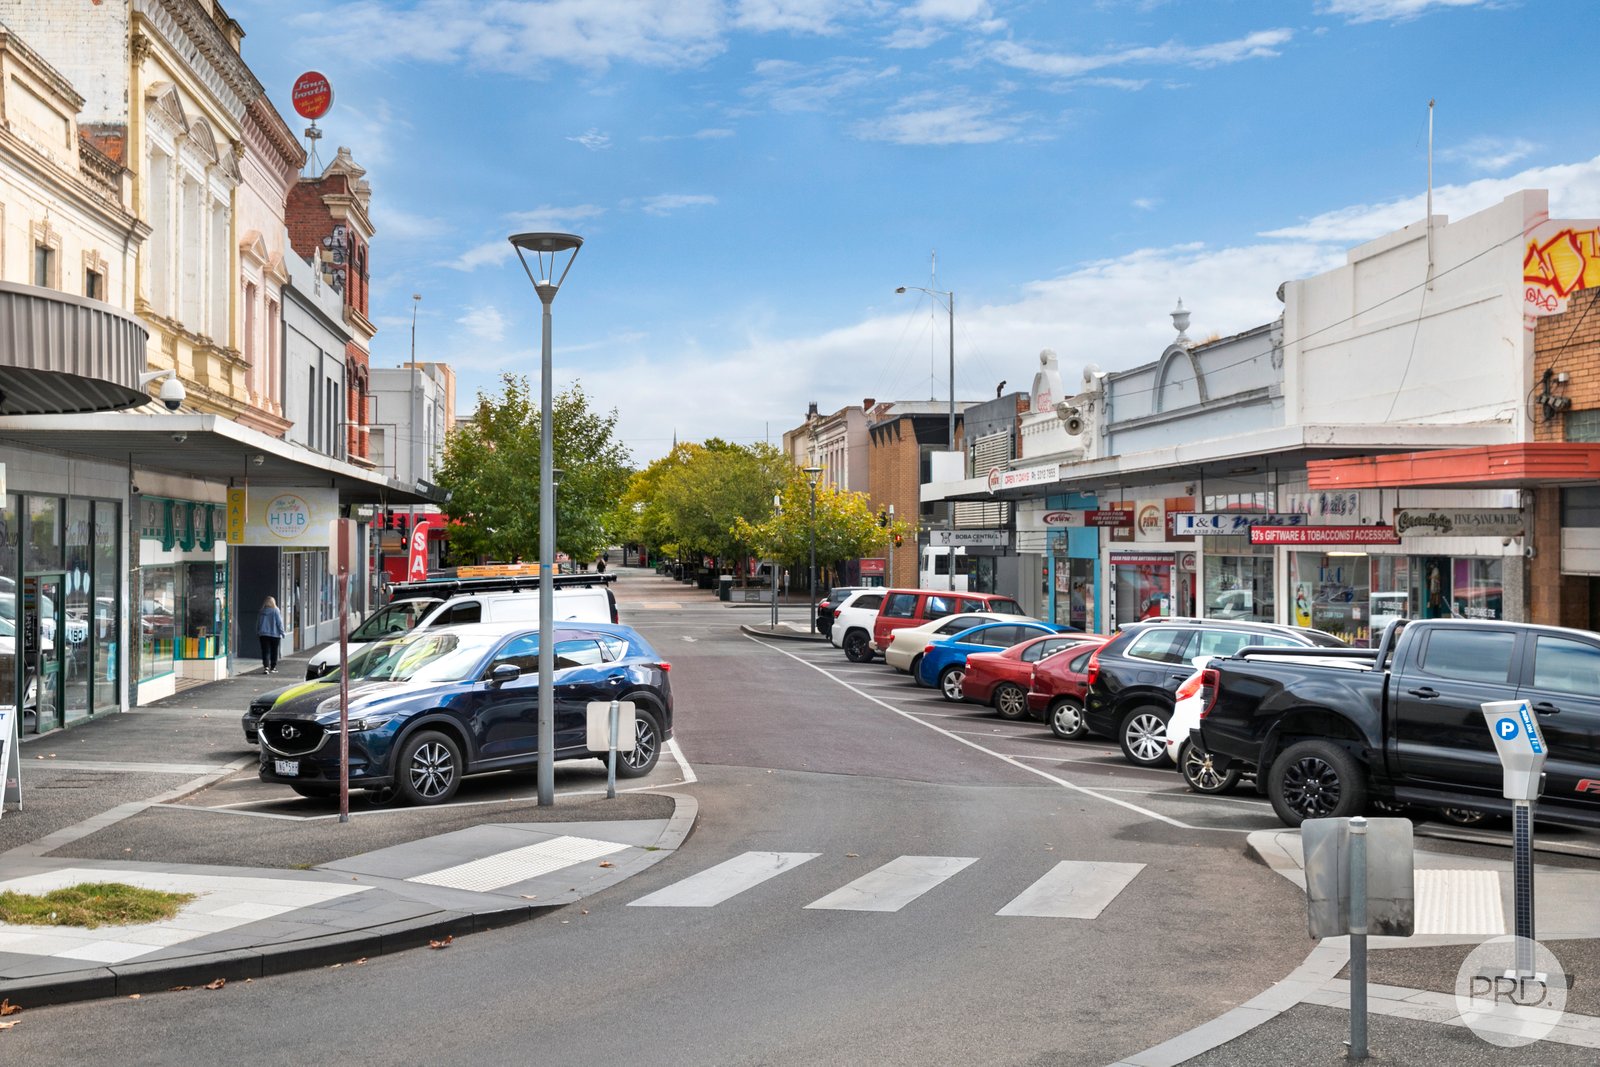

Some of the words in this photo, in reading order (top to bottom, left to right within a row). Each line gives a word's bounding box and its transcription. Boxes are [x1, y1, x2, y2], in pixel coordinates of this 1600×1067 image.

[270, 512, 306, 525] HUB
[1264, 530, 1299, 541] GIFTWARE
[1300, 530, 1306, 541] &
[1307, 529, 1354, 541] TOBACCONIST
[1501, 721, 1515, 737] P
